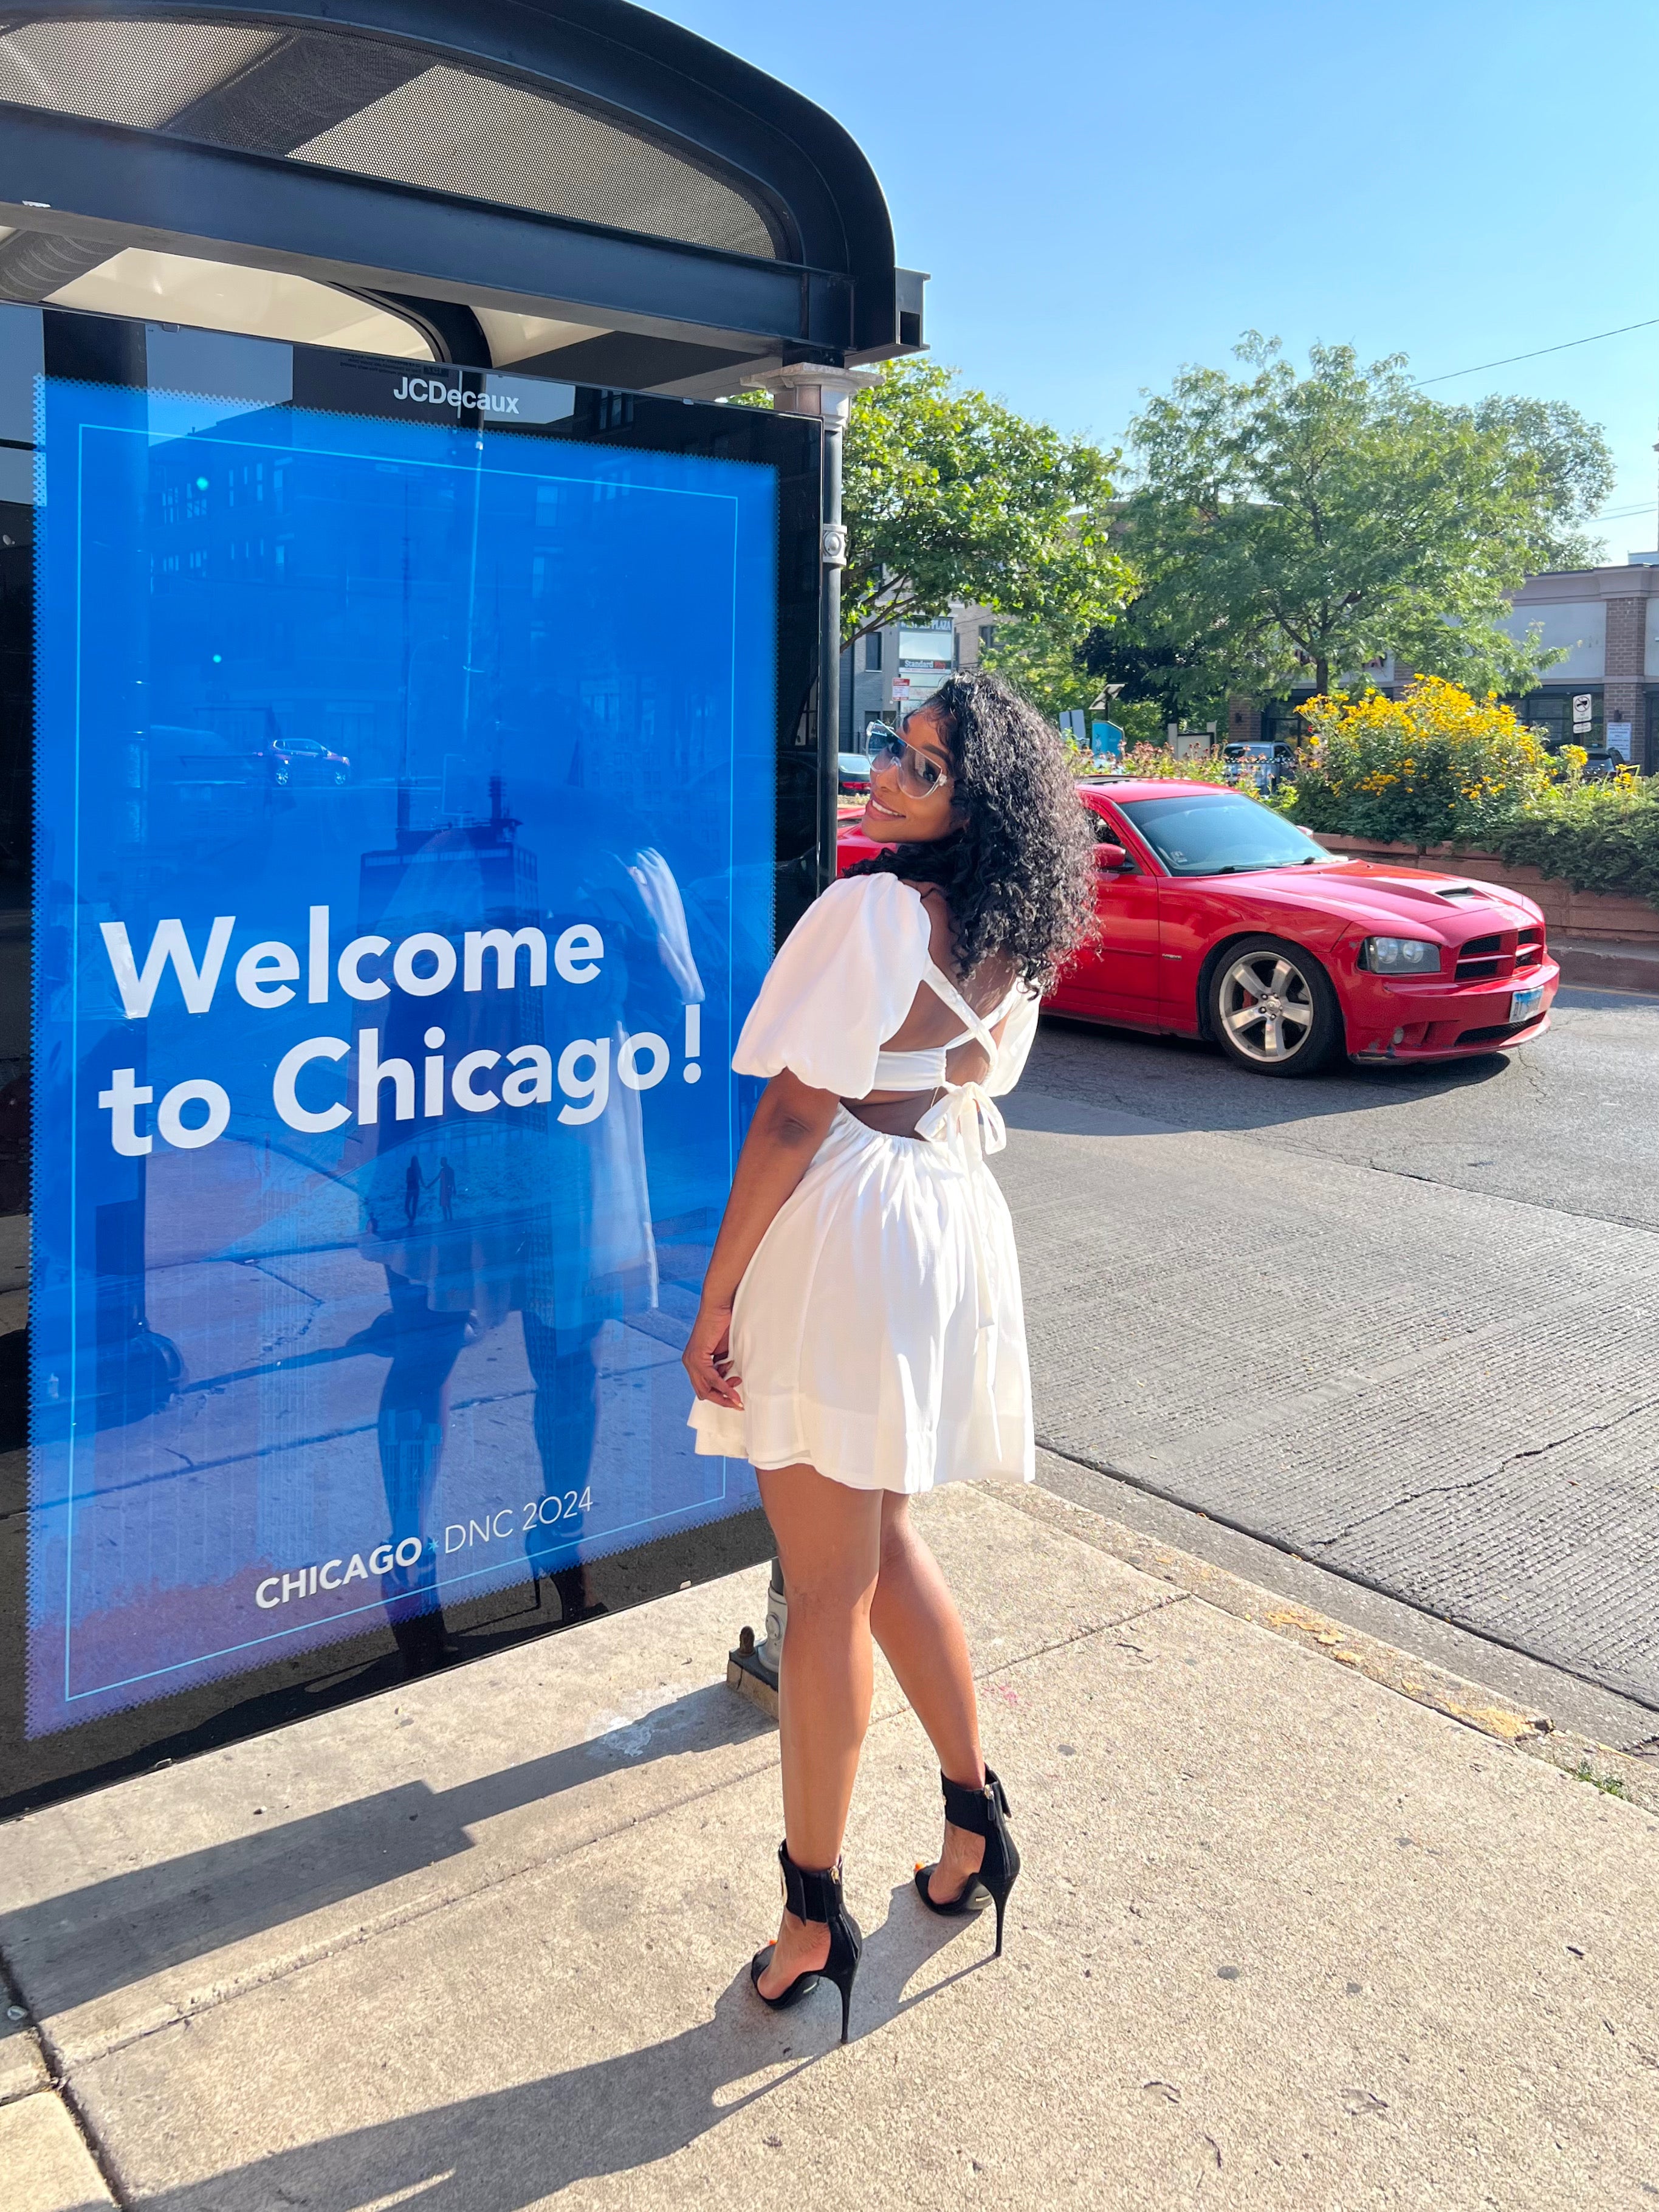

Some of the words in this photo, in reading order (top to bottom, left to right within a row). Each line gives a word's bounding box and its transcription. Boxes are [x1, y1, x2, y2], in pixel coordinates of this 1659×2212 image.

[394, 377, 520, 414] JCDecaux
[932, 619, 951, 630] PLAZA
[99, 905, 605, 1018] Welcome
[98, 1068, 230, 1157] to
[272, 1004, 702, 1134] Chicago!
[255, 1537, 422, 1609] CHICAGO
[444, 1510, 514, 1554] DNC
[522, 1486, 593, 1531] 2024
